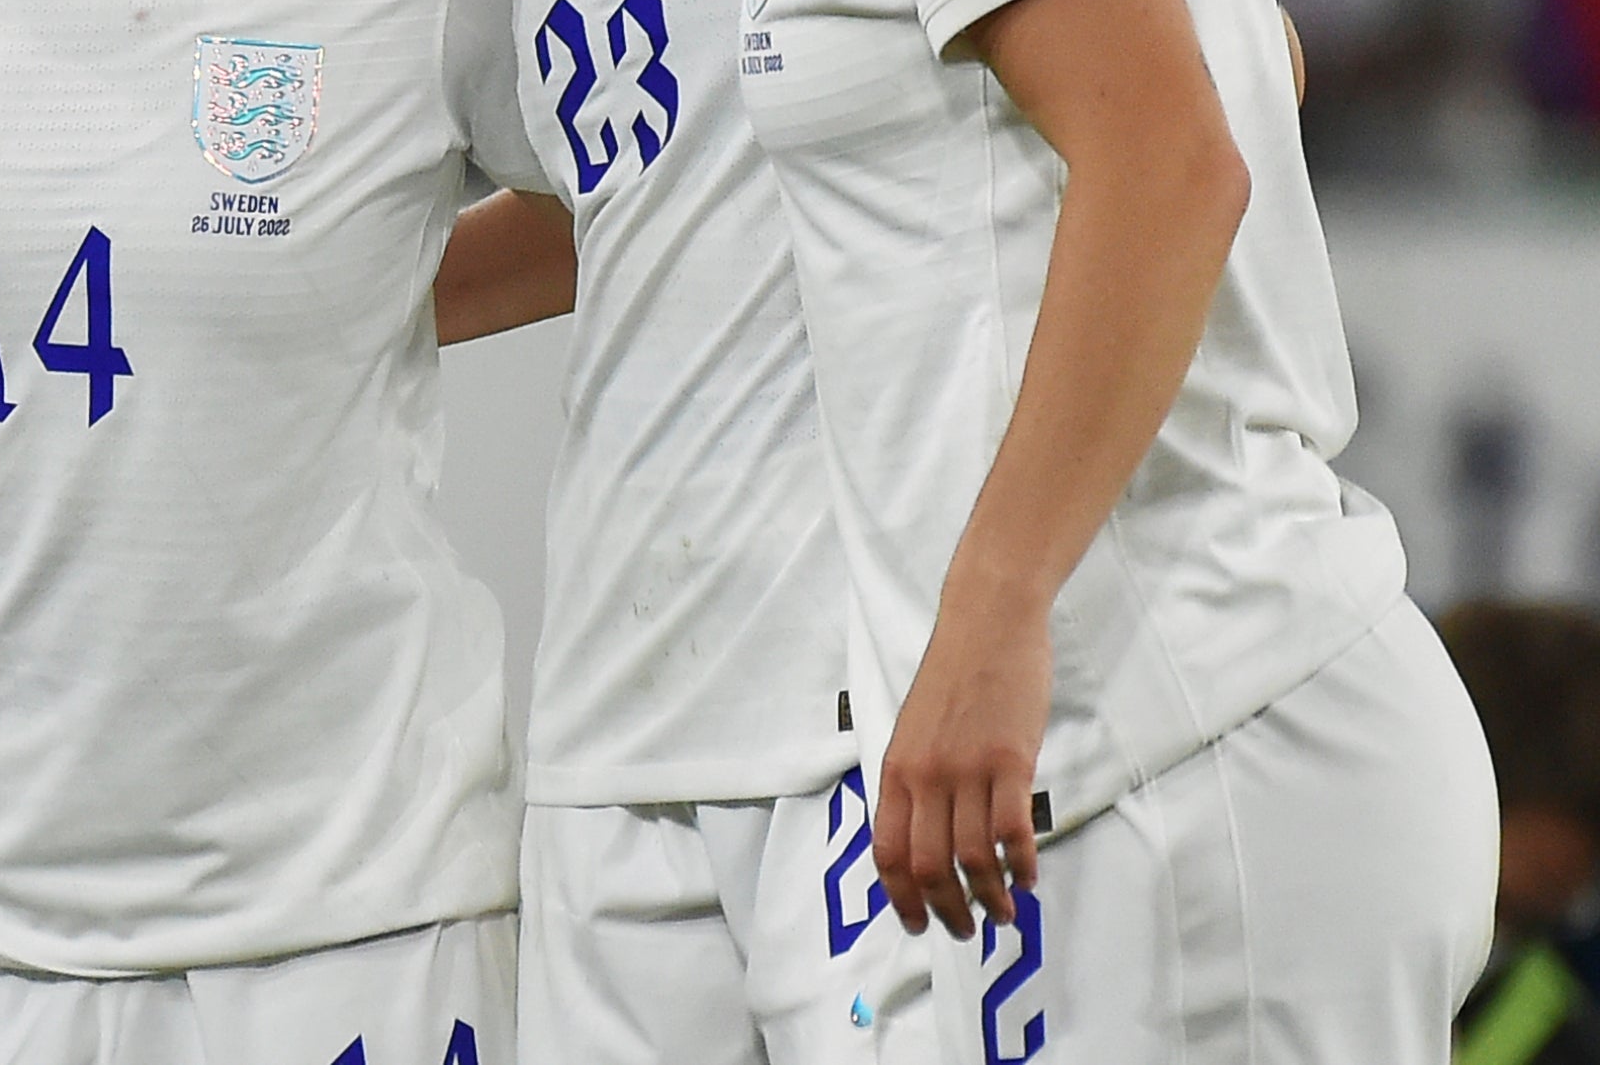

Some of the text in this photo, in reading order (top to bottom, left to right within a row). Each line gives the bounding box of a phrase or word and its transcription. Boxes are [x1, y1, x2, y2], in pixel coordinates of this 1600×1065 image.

[210, 192, 279, 214] SWEDEN
[191, 216, 291, 236] 26 JULY 2022
[981, 883, 1046, 1065] 2
